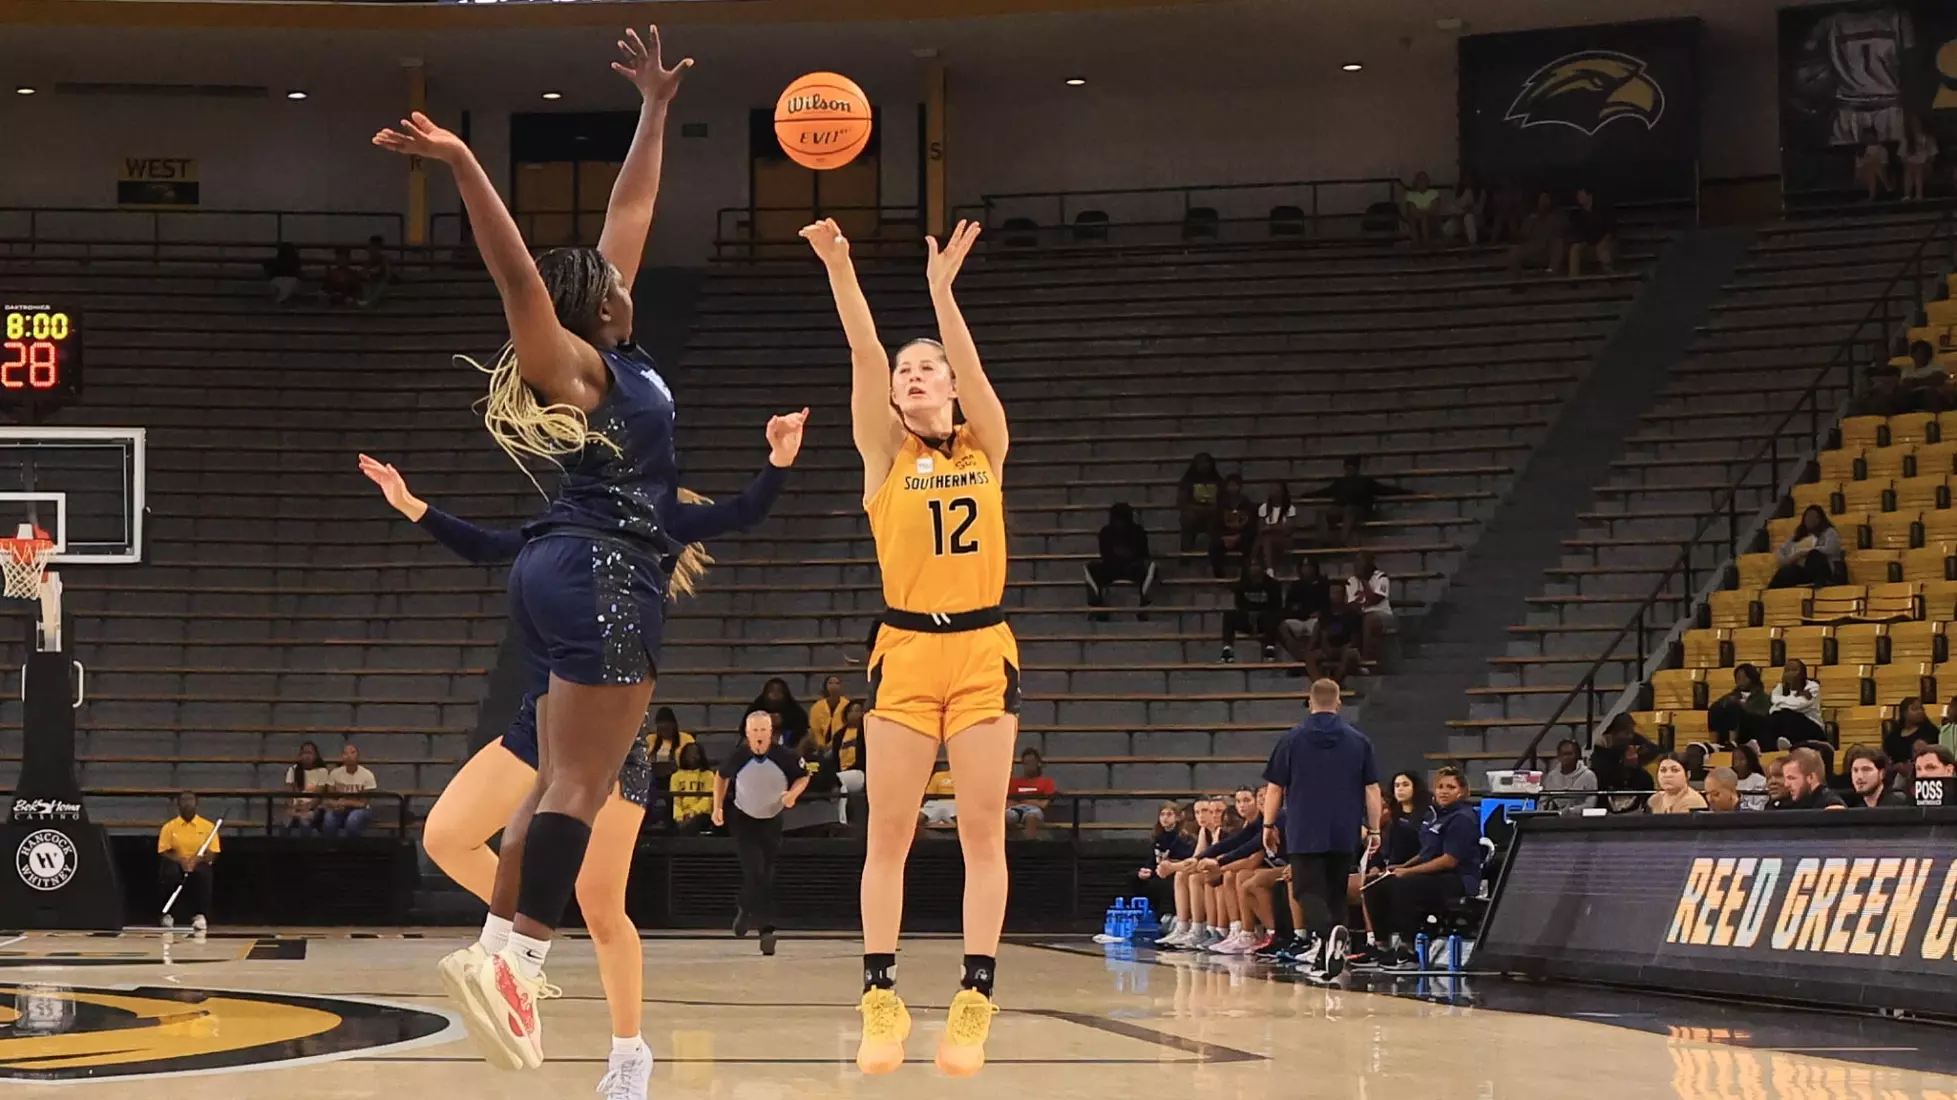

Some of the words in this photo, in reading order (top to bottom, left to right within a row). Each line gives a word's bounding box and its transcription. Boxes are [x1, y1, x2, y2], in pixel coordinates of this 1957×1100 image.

[788, 93, 852, 115] Wilson
[931, 142, 942, 161] S
[125, 158, 192, 178] WEST
[7, 312, 69, 340] 8:00
[1, 341, 56, 388] 28
[904, 474, 967, 490] SOUTHERN
[928, 497, 979, 556] 12
[1915, 780, 1943, 800] POSS
[21, 833, 73, 857] HANCOCK
[21, 863, 72, 888] WHITNEY
[1666, 857, 1783, 948] REED
[1770, 857, 1934, 957] GREEN
